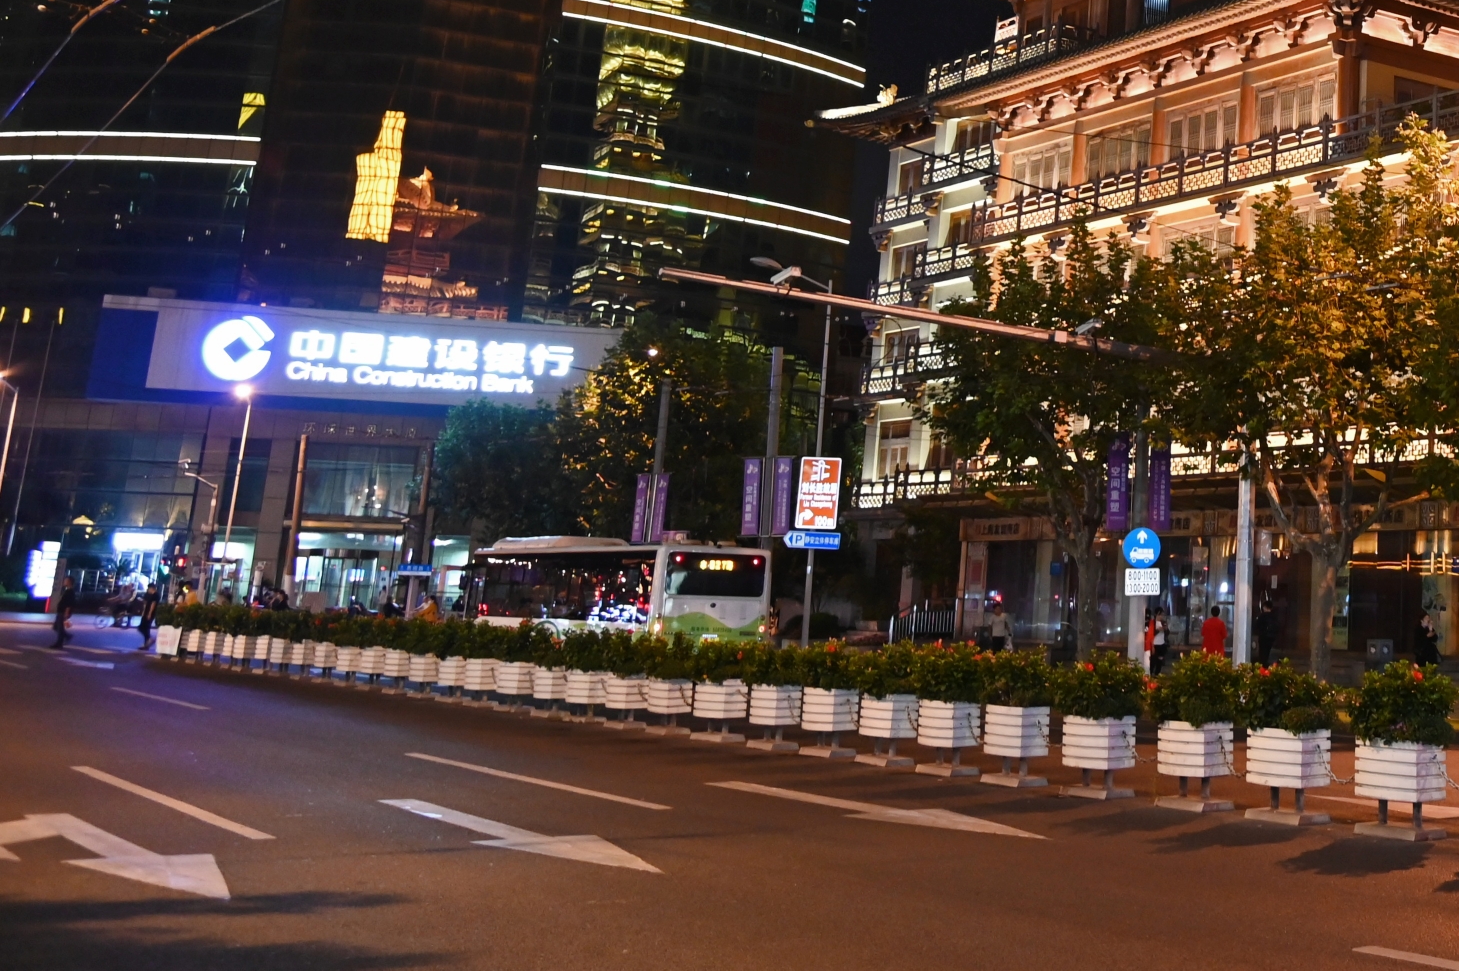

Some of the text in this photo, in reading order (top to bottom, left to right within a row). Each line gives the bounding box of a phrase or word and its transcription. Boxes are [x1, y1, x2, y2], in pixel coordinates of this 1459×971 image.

[289, 330, 574, 377] 中国建设银行
[285, 361, 534, 394] China Construction Bank
[1110, 466, 1121, 513] 空间重塑
